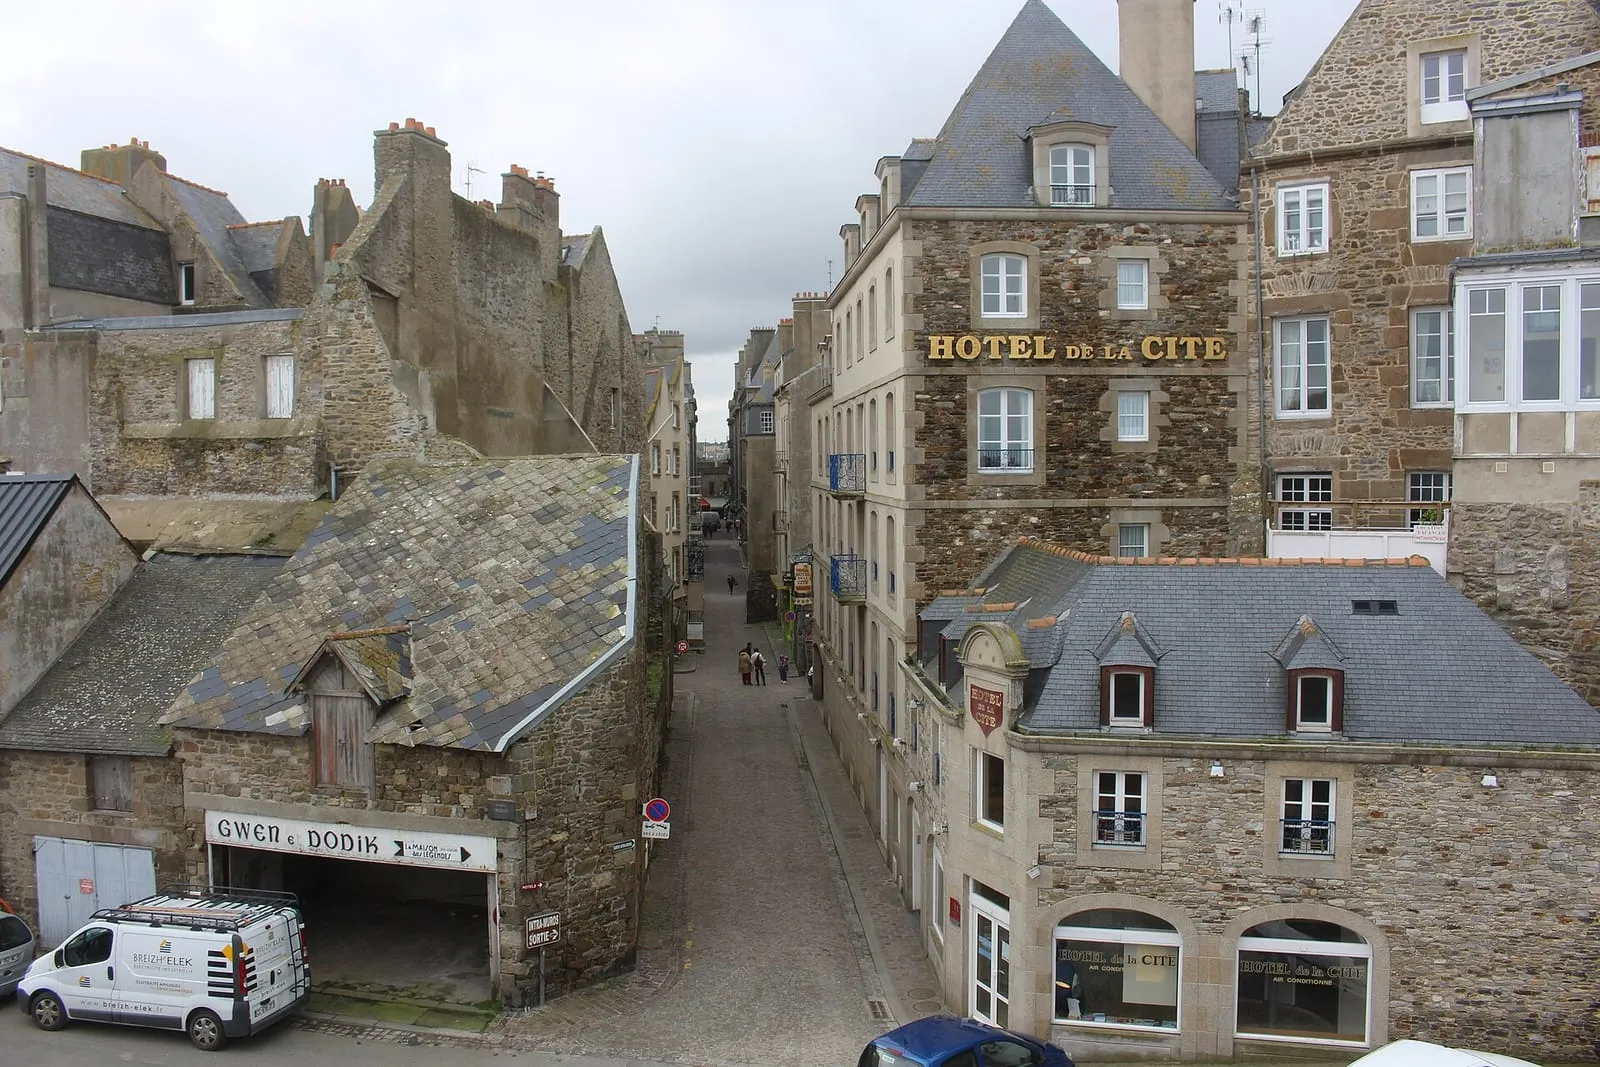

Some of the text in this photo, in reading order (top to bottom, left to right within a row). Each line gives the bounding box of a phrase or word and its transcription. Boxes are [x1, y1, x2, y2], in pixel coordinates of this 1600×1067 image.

[928, 335, 1228, 360] HOTEL DE LA CITE
[971, 688, 1002, 707] HOTEL
[529, 931, 550, 945] SORTIE
[133, 953, 193, 967] BREIZH'ELEK
[1057, 949, 1107, 963] HOTEL
[1127, 954, 1137, 964] la
[1240, 960, 1291, 975] HOTEL
[1295, 965, 1310, 976] de
[1312, 966, 1324, 977] la
[1286, 977, 1333, 986] CONDITIONNE
